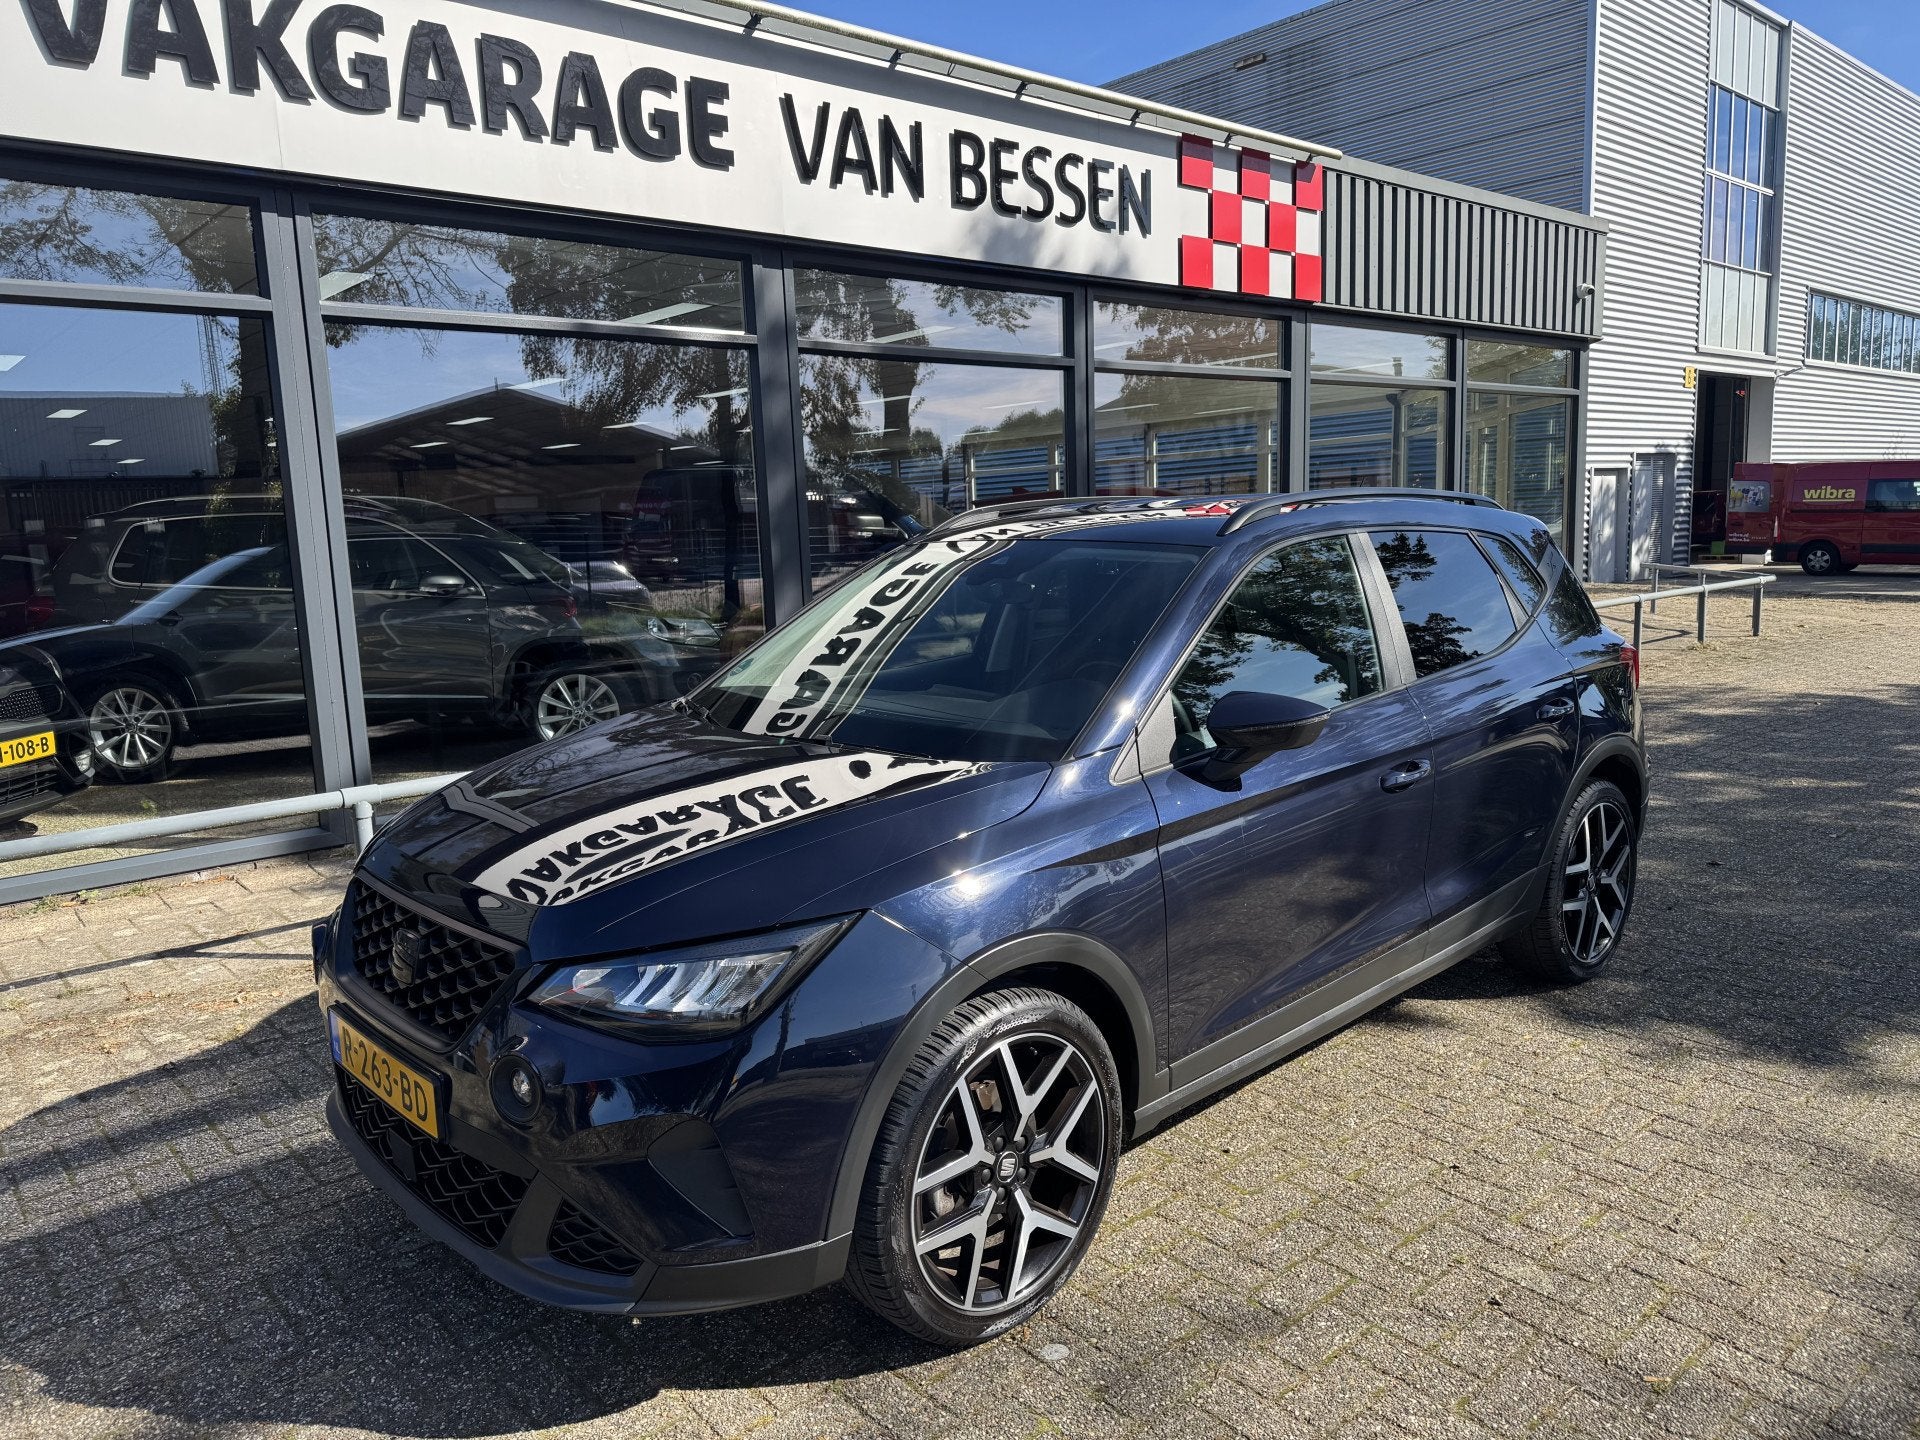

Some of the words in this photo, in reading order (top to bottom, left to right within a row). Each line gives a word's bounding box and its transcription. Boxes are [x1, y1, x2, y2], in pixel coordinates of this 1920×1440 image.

[16, 0, 734, 171] VAKGARAGE
[779, 93, 924, 202] VAN
[950, 129, 1152, 236] BESSEN
[1803, 485, 1856, 499] wibra
[0, 736, 50, 763] -108-B
[341, 1025, 428, 1122] R-263-BD
